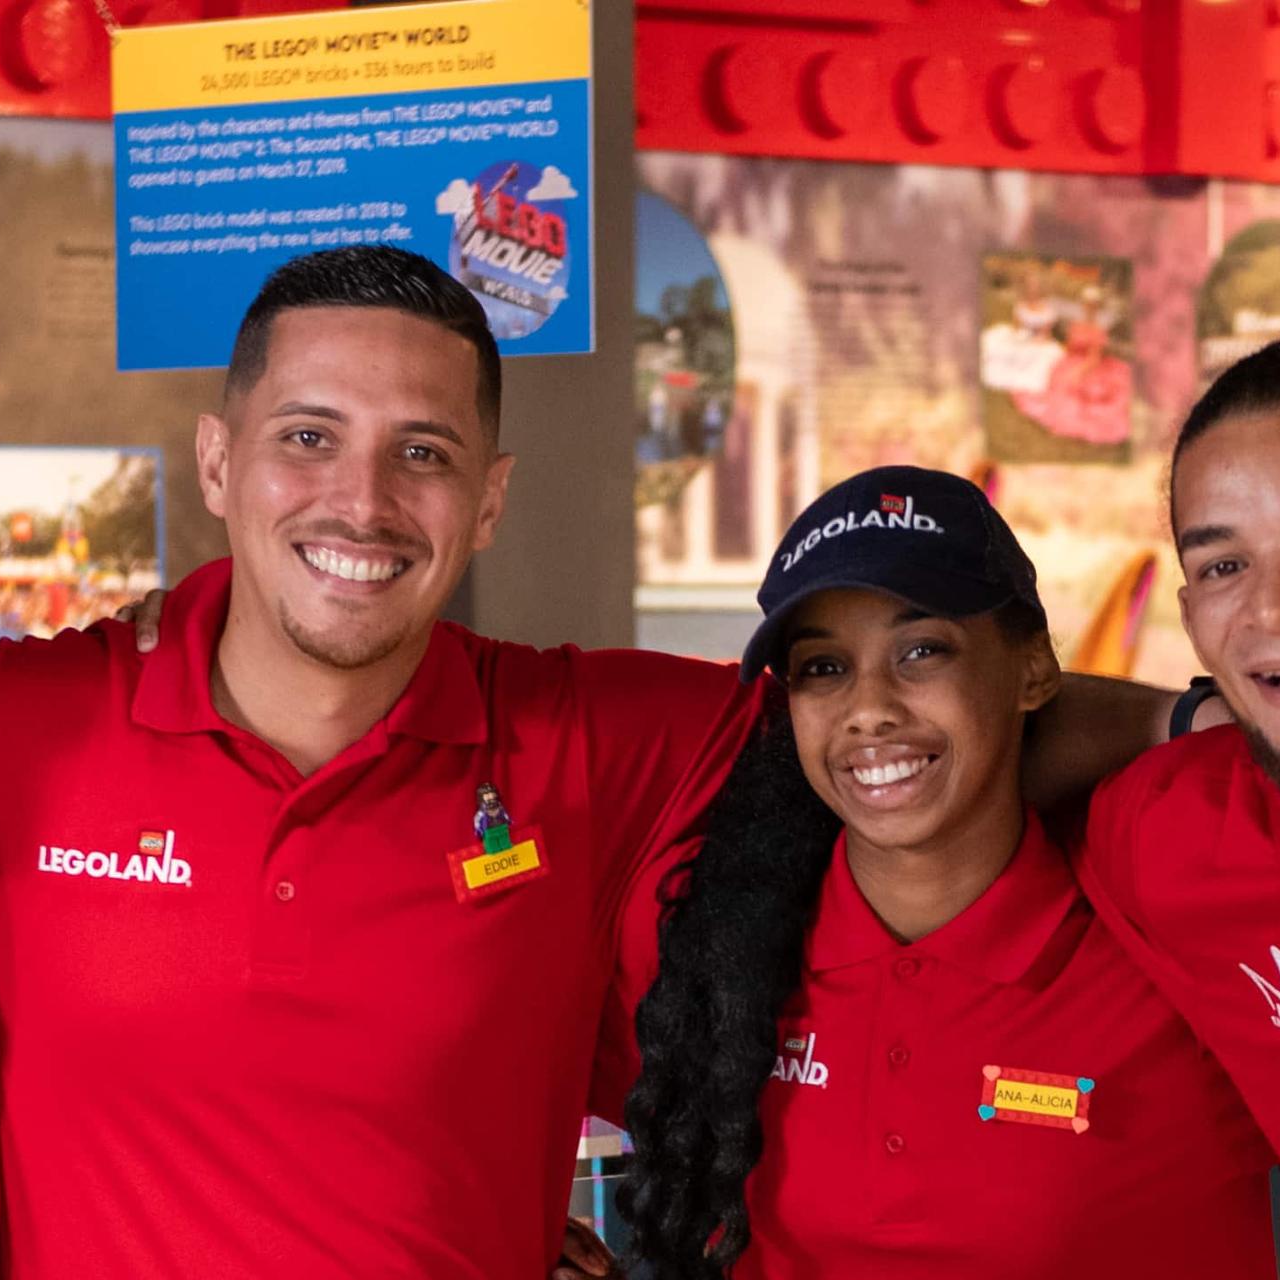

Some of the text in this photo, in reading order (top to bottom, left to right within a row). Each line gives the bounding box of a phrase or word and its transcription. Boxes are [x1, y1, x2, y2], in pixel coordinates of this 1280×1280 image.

[223, 42, 257, 62] THE
[404, 25, 471, 46] WORLD
[305, 65, 349, 83] bricks
[393, 58, 434, 76] hours
[437, 58, 455, 73] to
[457, 52, 497, 72] build
[179, 120, 196, 142] by
[197, 119, 219, 138] the
[220, 117, 286, 136] characters
[287, 112, 313, 131] and
[314, 111, 360, 129] themes
[361, 107, 392, 125] from
[393, 105, 419, 123] THE
[525, 94, 553, 113] and
[128, 147, 153, 164] THE
[269, 137, 294, 154] The
[295, 133, 343, 154] Second
[376, 129, 401, 147] THE
[506, 119, 559, 138] WORLD
[128, 168, 178, 189] opened
[179, 168, 193, 185] to
[195, 166, 236, 187] guests
[238, 166, 255, 181] on
[256, 161, 295, 180] March
[129, 215, 156, 232] This
[157, 213, 192, 231] LEGO
[193, 210, 225, 230] brick
[227, 208, 268, 227] model
[269, 209, 293, 225] was
[294, 204, 343, 223] created
[344, 202, 358, 219] in
[390, 201, 408, 218] to
[472, 182, 568, 260] LEGO
[129, 238, 191, 256] showcase
[192, 232, 257, 254] everything
[258, 230, 280, 248] the
[281, 231, 310, 247] new
[311, 227, 339, 246] land
[340, 226, 363, 243] has
[364, 226, 380, 242] to
[461, 228, 564, 285] MOVIE
[37, 829, 192, 887] LEGOLAND
[483, 853, 520, 876] EDDIE
[996, 1089, 1073, 1110] ANA-ALICIA
